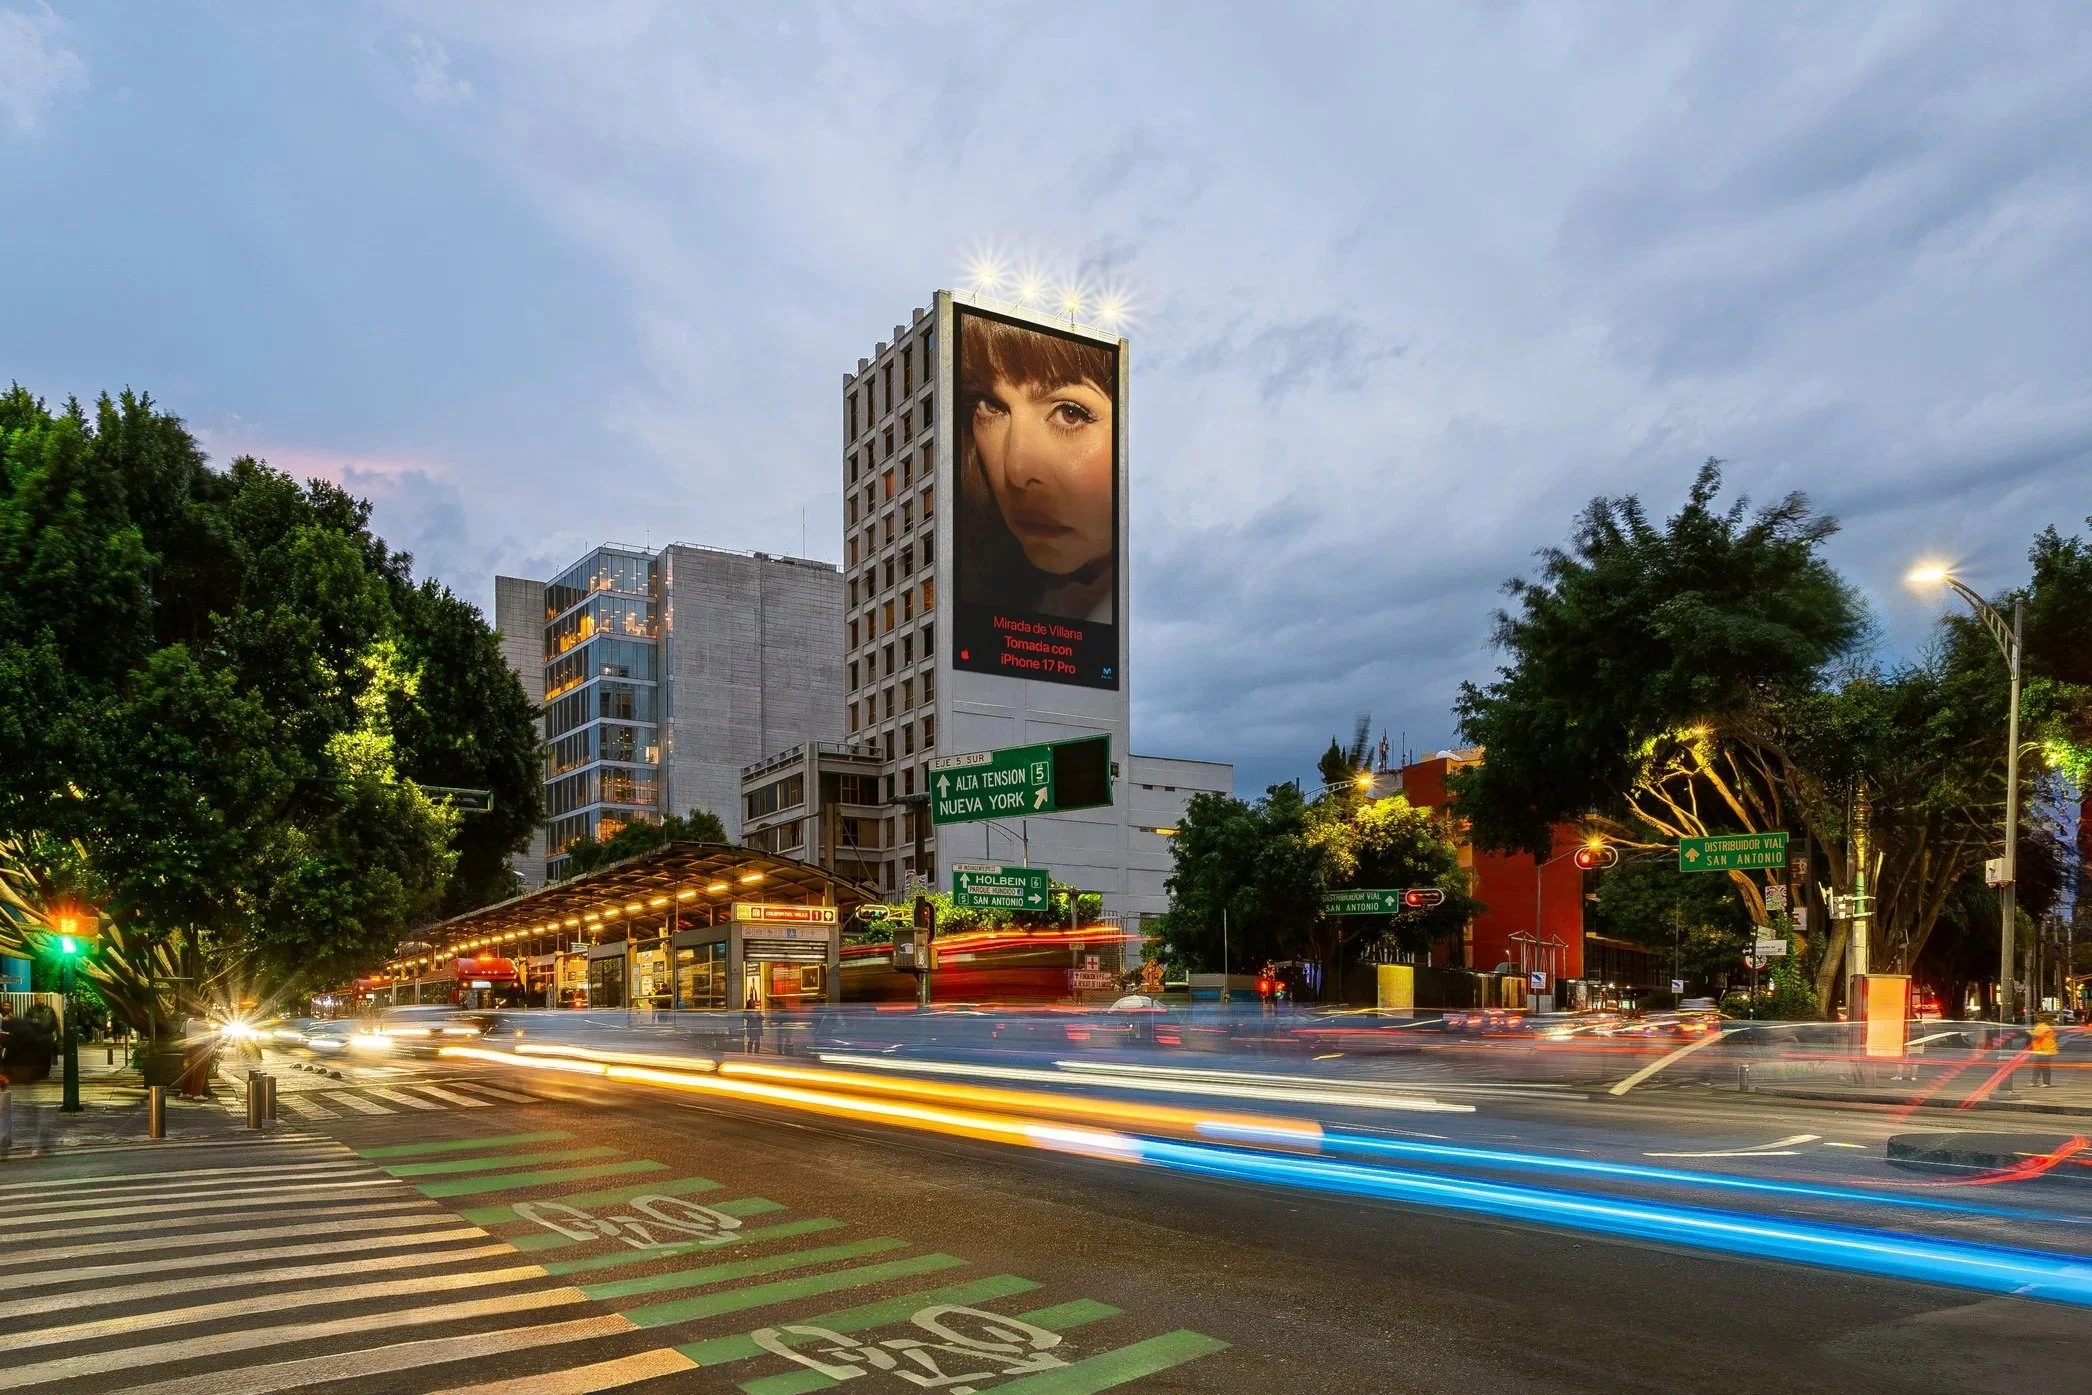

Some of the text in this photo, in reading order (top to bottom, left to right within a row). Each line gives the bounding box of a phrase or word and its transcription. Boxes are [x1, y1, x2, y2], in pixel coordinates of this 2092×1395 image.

[993, 616, 1083, 640] Mirada de Villana
[1004, 635, 1073, 656] Tomada con
[1000, 653, 1076, 675] iPhone 17 Pro
[936, 754, 984, 768] EJE 5 SUR
[956, 768, 1025, 791] ALTA TENSION
[1036, 767, 1044, 779] 5
[940, 791, 1025, 815] NUEVA YORK
[1704, 838, 1785, 852] DISTRIBUIDOR VIAL
[1706, 852, 1781, 866] SAN ANTONIO
[975, 875, 1026, 886] HOLBEIN
[969, 886, 990, 894] PARQUE
[1366, 892, 1381, 900] VIAL
[973, 896, 1024, 907] SAN ANTONIO
[1325, 902, 1379, 912] SAN ANTONIO
[814, 911, 819, 920] 1
